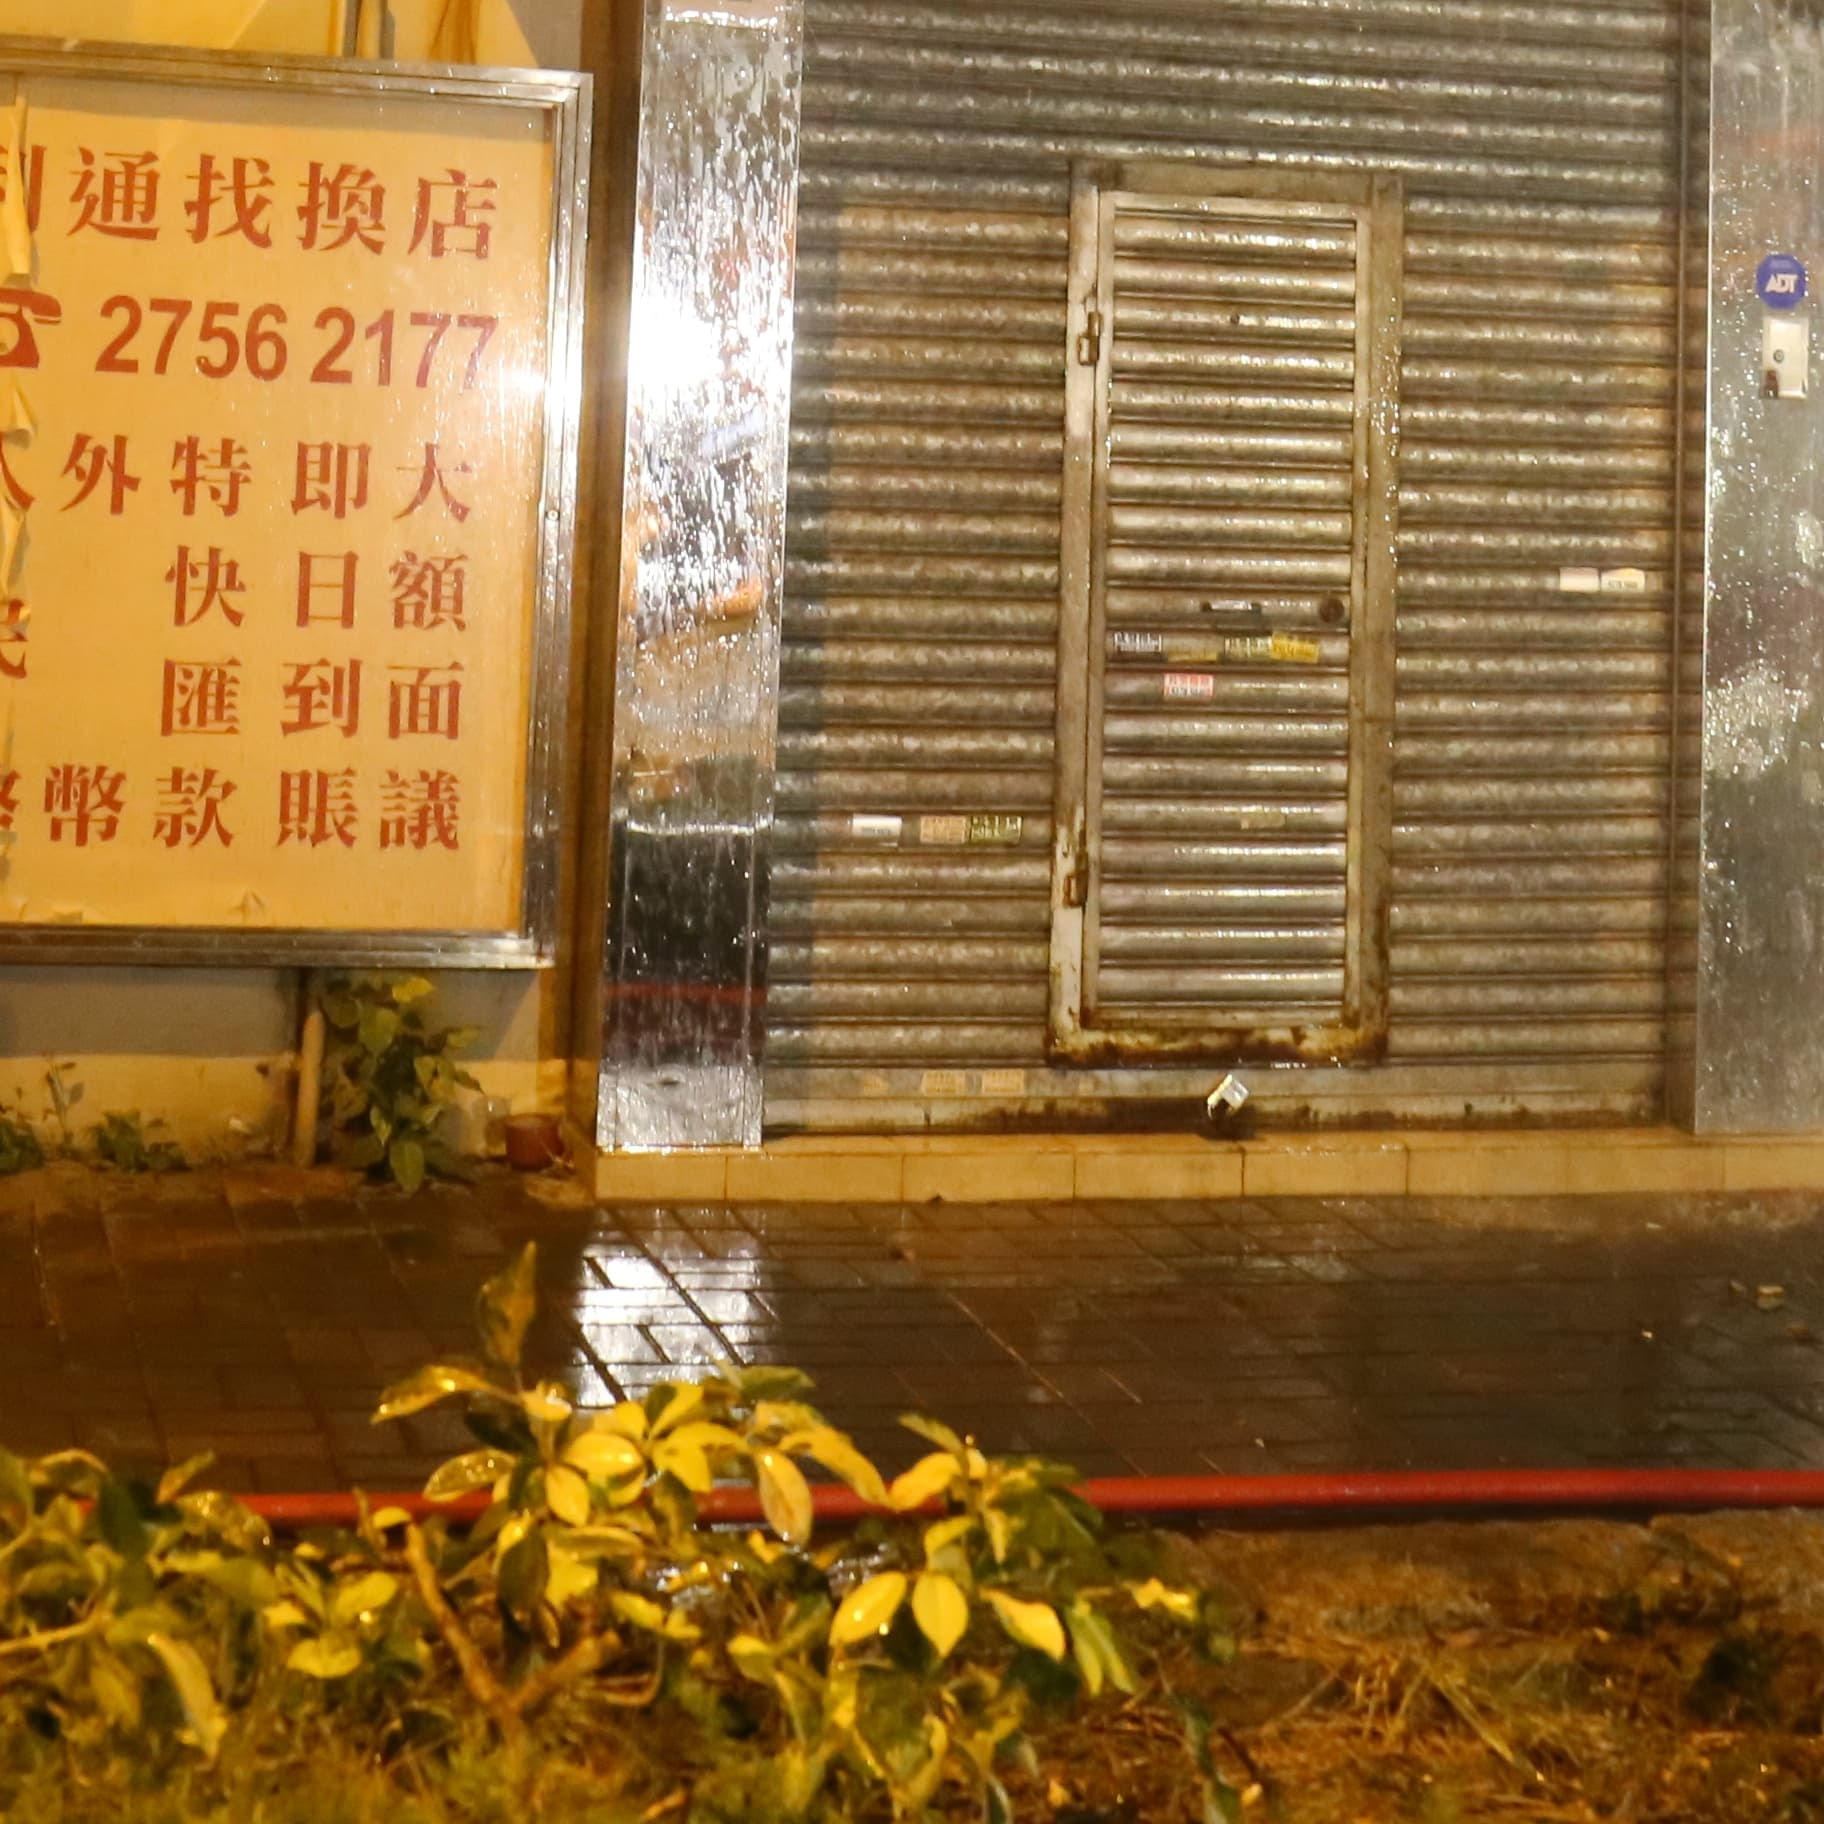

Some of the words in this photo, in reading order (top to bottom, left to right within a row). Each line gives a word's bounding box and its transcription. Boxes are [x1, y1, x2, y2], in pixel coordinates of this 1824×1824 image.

[94, 293, 288, 382] 2756
[310, 306, 500, 390] 2177
[1764, 273, 1799, 295] ADT
[43, 432, 142, 848] 外幣
[152, 434, 253, 849] 特快匯款
[378, 442, 474, 851] 大額面議
